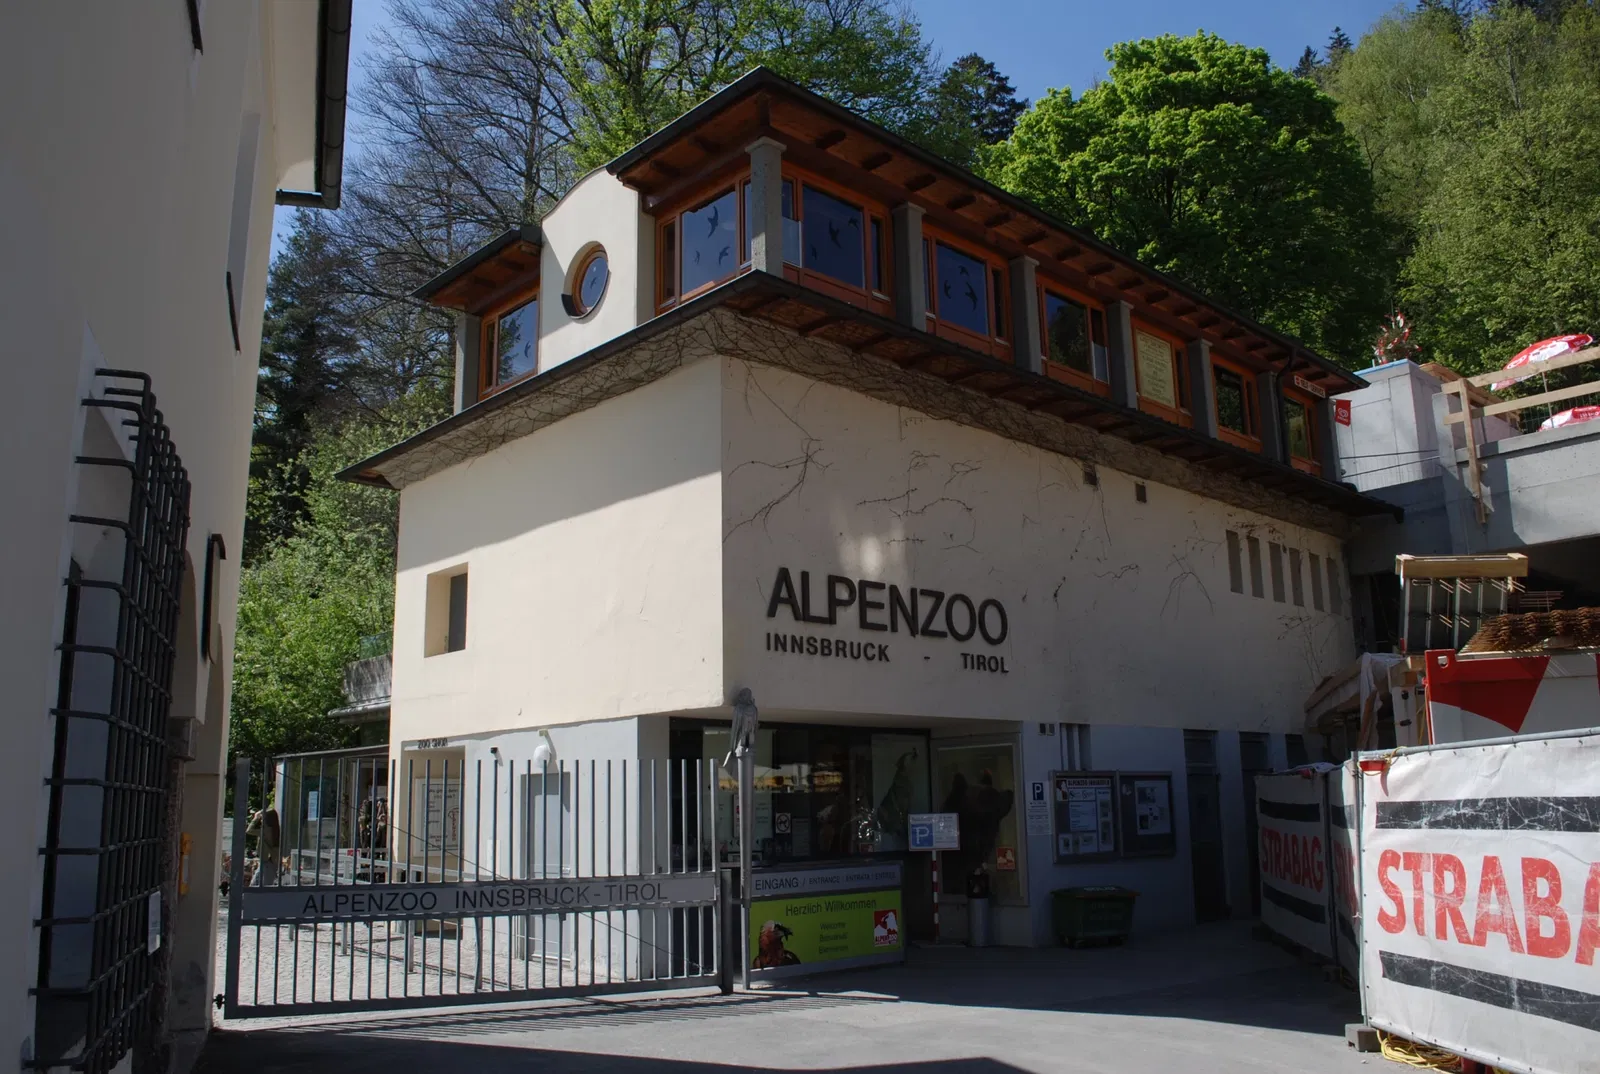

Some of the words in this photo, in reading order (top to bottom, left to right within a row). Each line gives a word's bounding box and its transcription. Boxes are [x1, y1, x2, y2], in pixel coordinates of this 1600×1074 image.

[767, 567, 1008, 646] ALPENZOO
[766, 632, 890, 662] INNSBRUCK
[960, 652, 1009, 674] TIROL
[418, 740, 431, 749] ZOO
[1035, 784, 1042, 800] P
[913, 827, 930, 845] P
[1261, 826, 1324, 893] STRABAG
[755, 877, 799, 892] EINGANG
[809, 876, 840, 887] ENTRANCE
[303, 890, 438, 914] ALPENZOO
[785, 902, 822, 917] Herzlich
[825, 898, 877, 914] Willkommen
